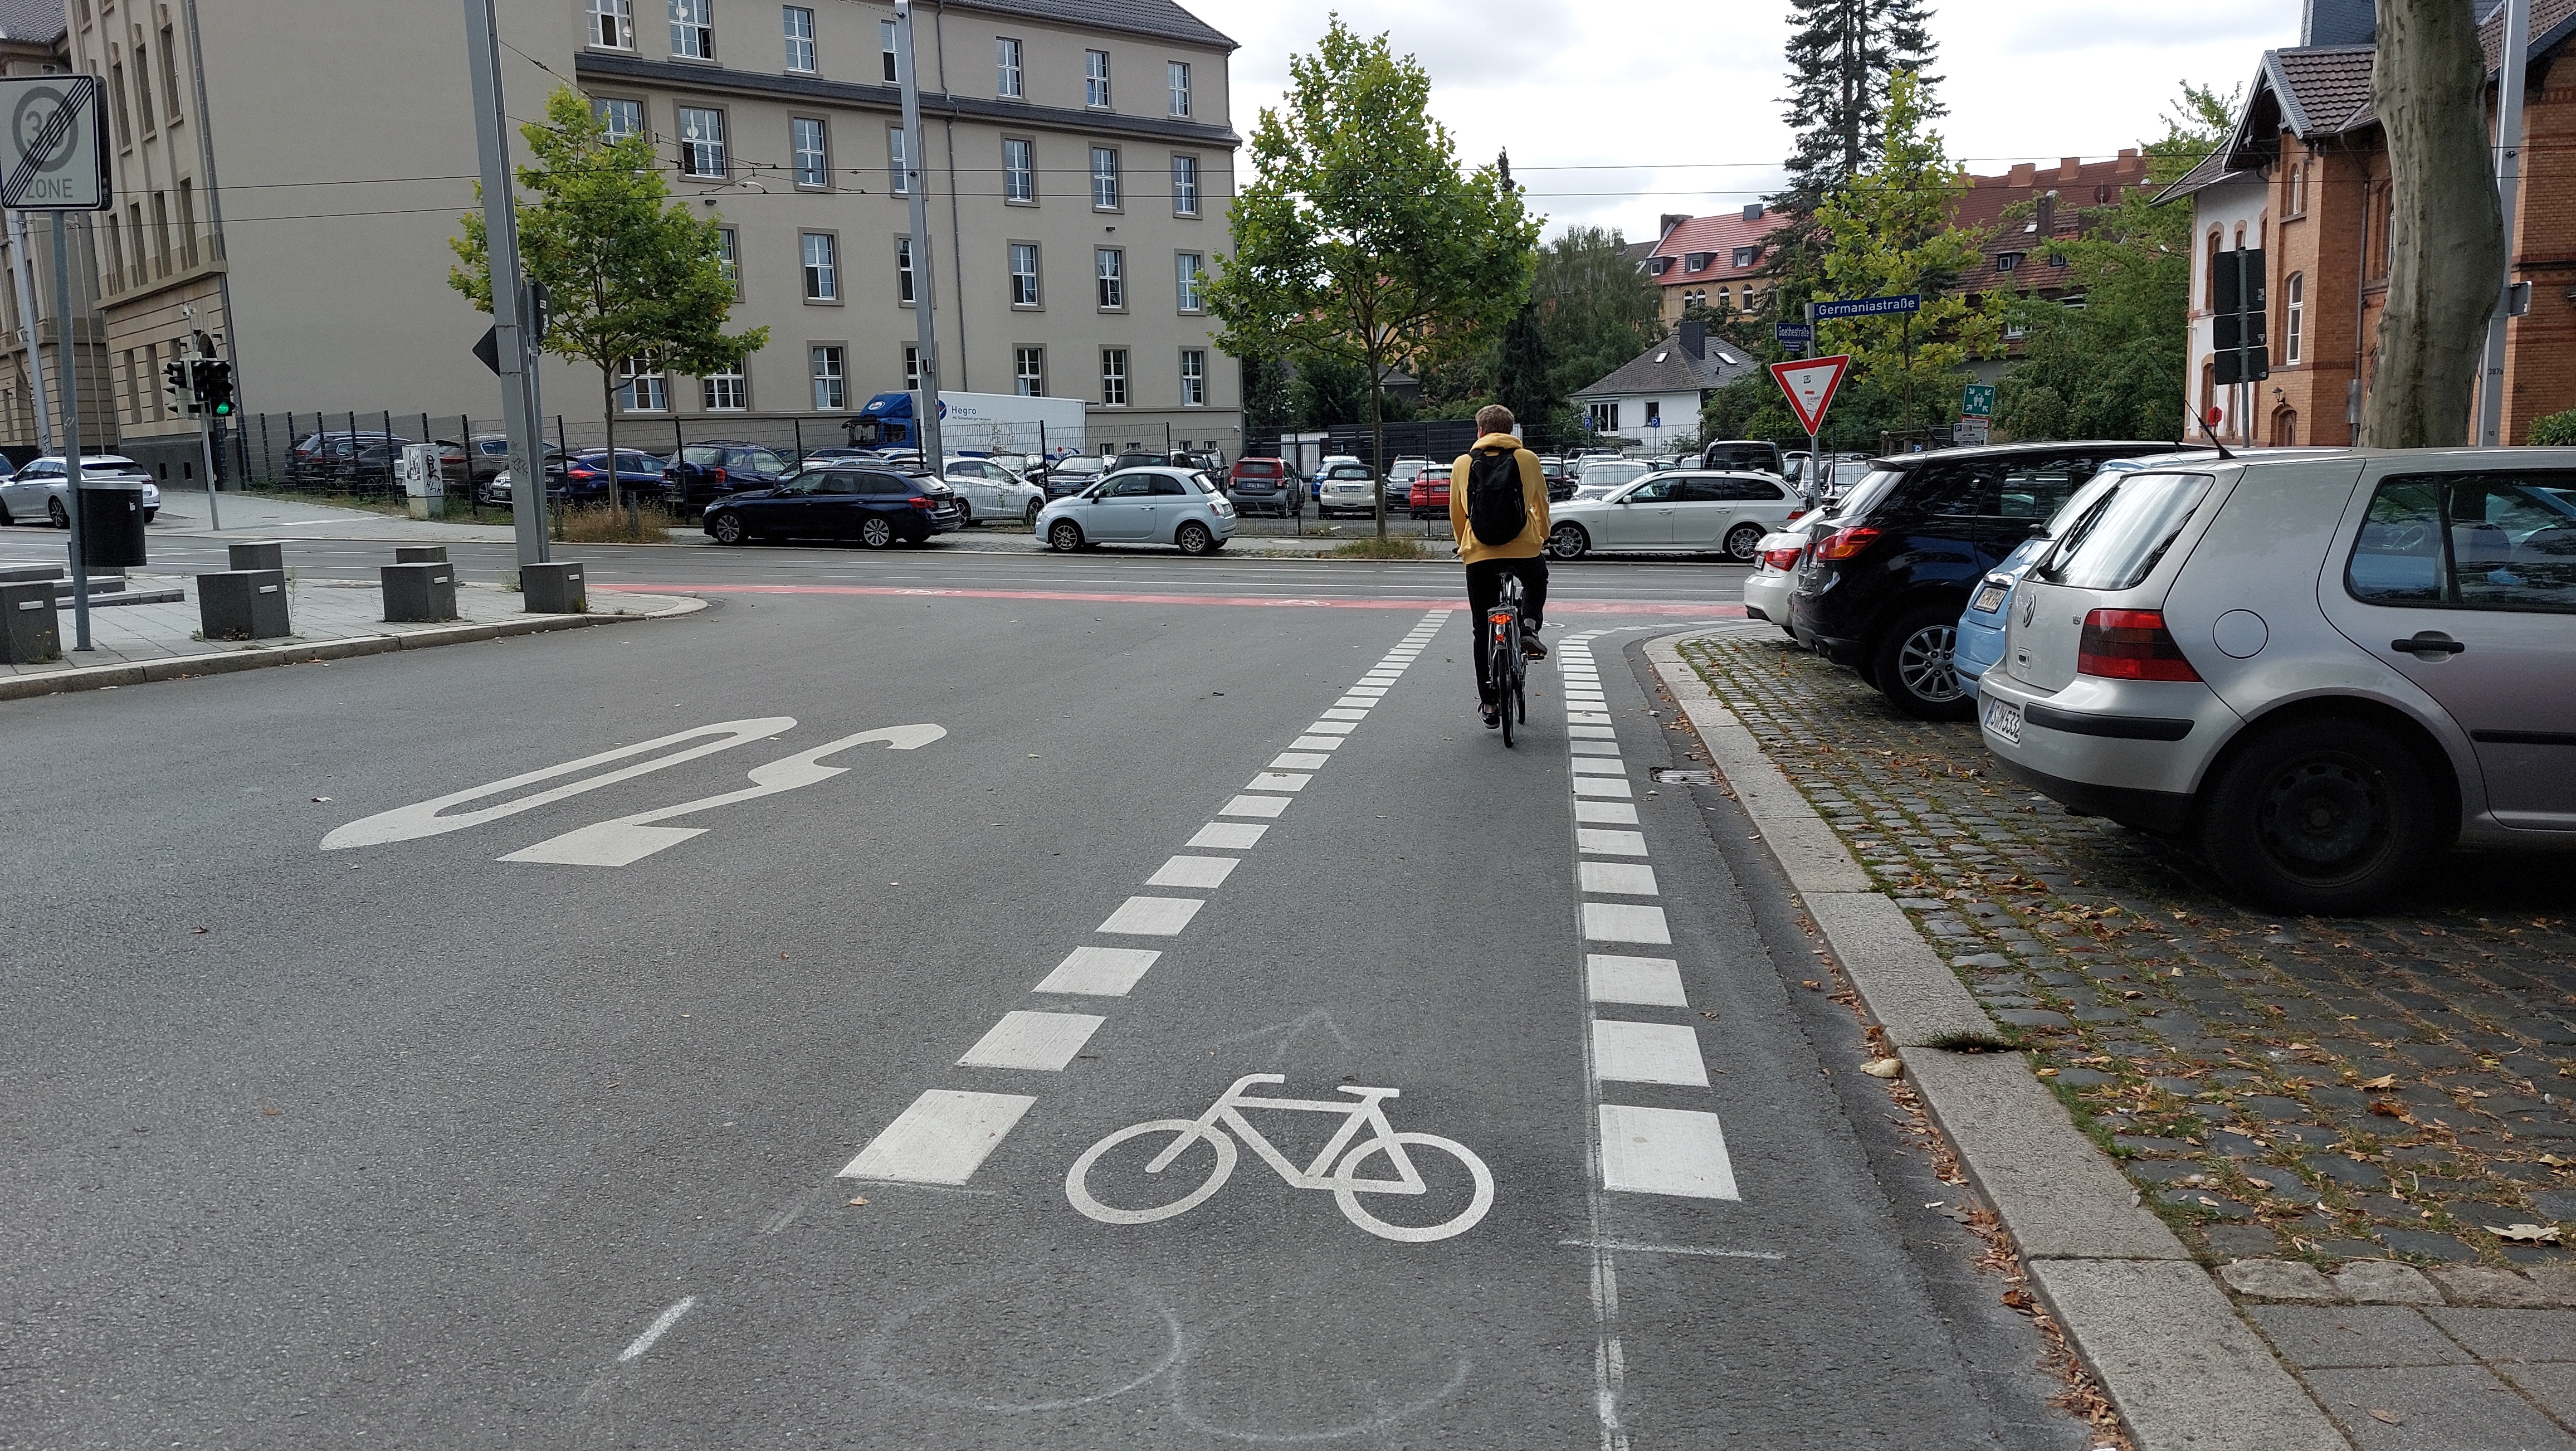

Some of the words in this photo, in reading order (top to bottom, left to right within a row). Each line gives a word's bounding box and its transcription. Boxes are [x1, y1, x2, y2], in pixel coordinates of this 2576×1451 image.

[26, 110, 64, 149] 30
[26, 178, 73, 198] ZONE
[1818, 298, 1915, 315] Germaniastraße
[1778, 325, 1809, 338] Goethestraße
[952, 406, 977, 416] Hegro
